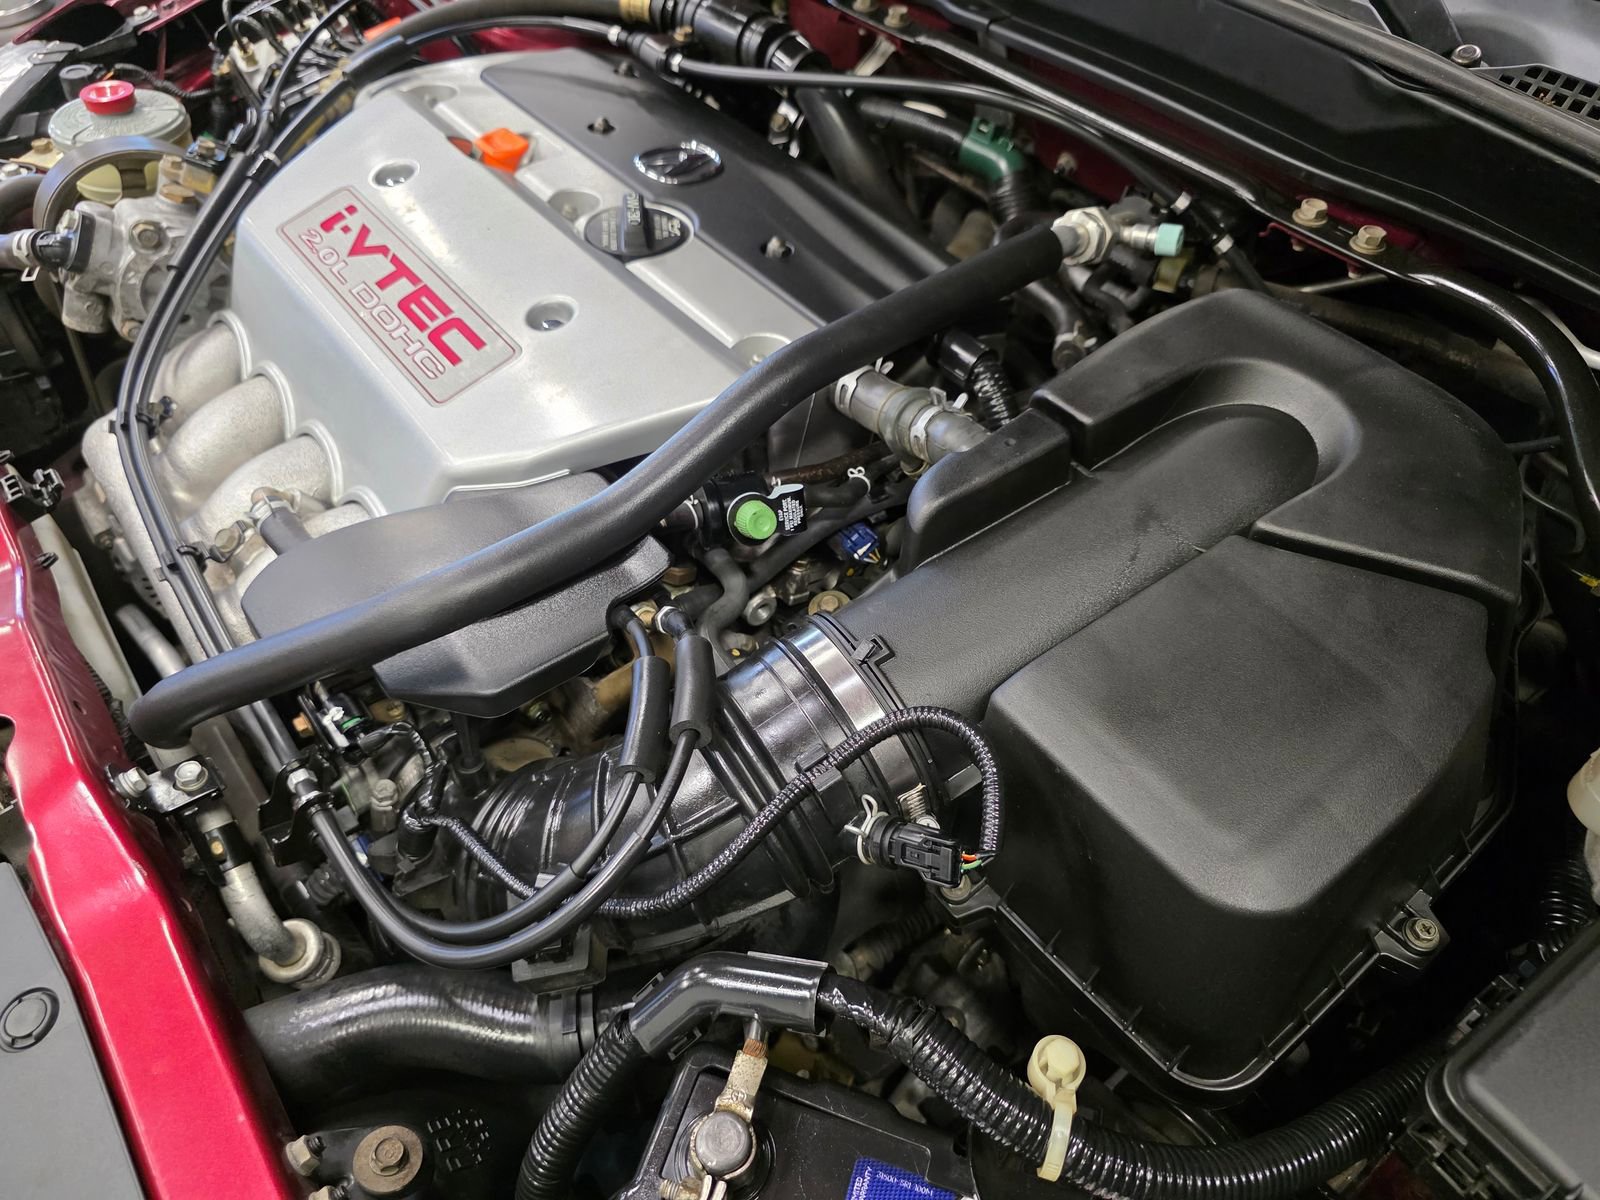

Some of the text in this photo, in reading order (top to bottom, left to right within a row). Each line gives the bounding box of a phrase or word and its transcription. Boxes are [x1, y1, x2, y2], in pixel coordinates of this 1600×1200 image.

[299, 228, 446, 380] 2.0L DOHC
[320, 204, 487, 366] i-VTEC
[850, 1176, 863, 1200] MITED
[858, 1166, 872, 1200] ARRANTY
